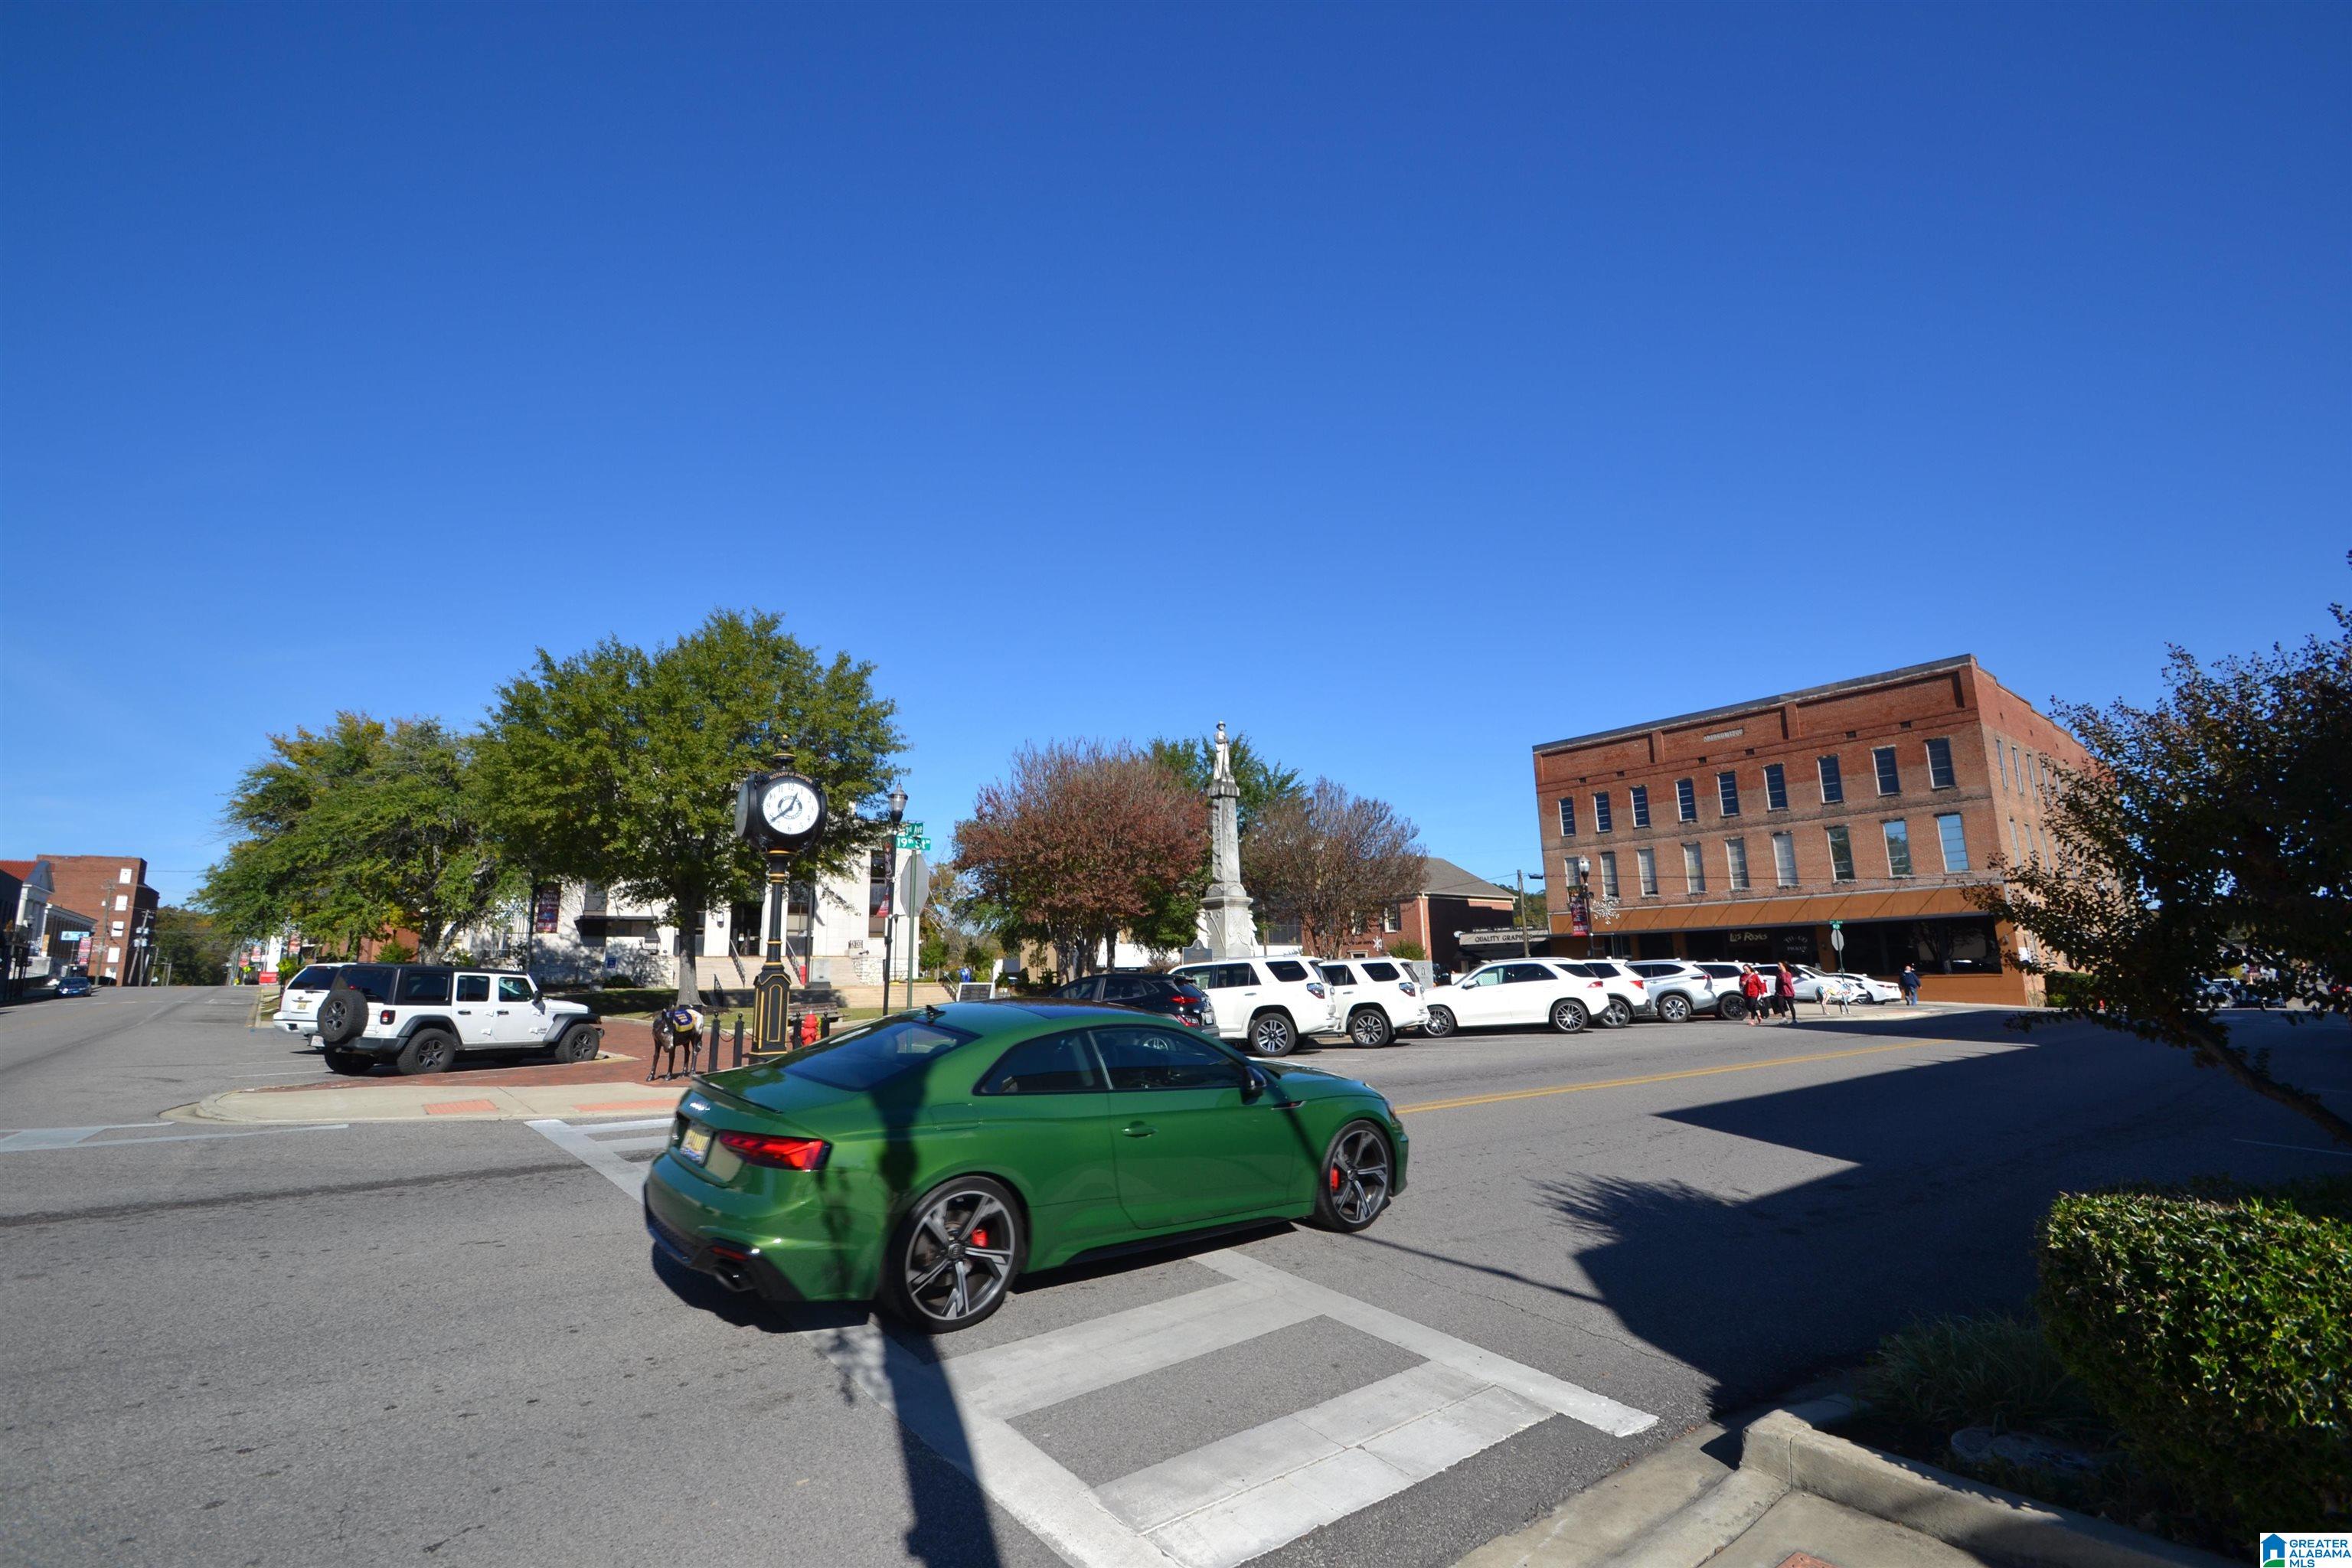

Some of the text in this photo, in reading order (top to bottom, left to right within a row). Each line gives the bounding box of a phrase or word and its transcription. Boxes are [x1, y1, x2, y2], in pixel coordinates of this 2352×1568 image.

[769, 771, 789, 780] ROTARY
[795, 772, 813, 784] JASPER
[788, 782, 795, 791] 12
[913, 825, 923, 835] Ave
